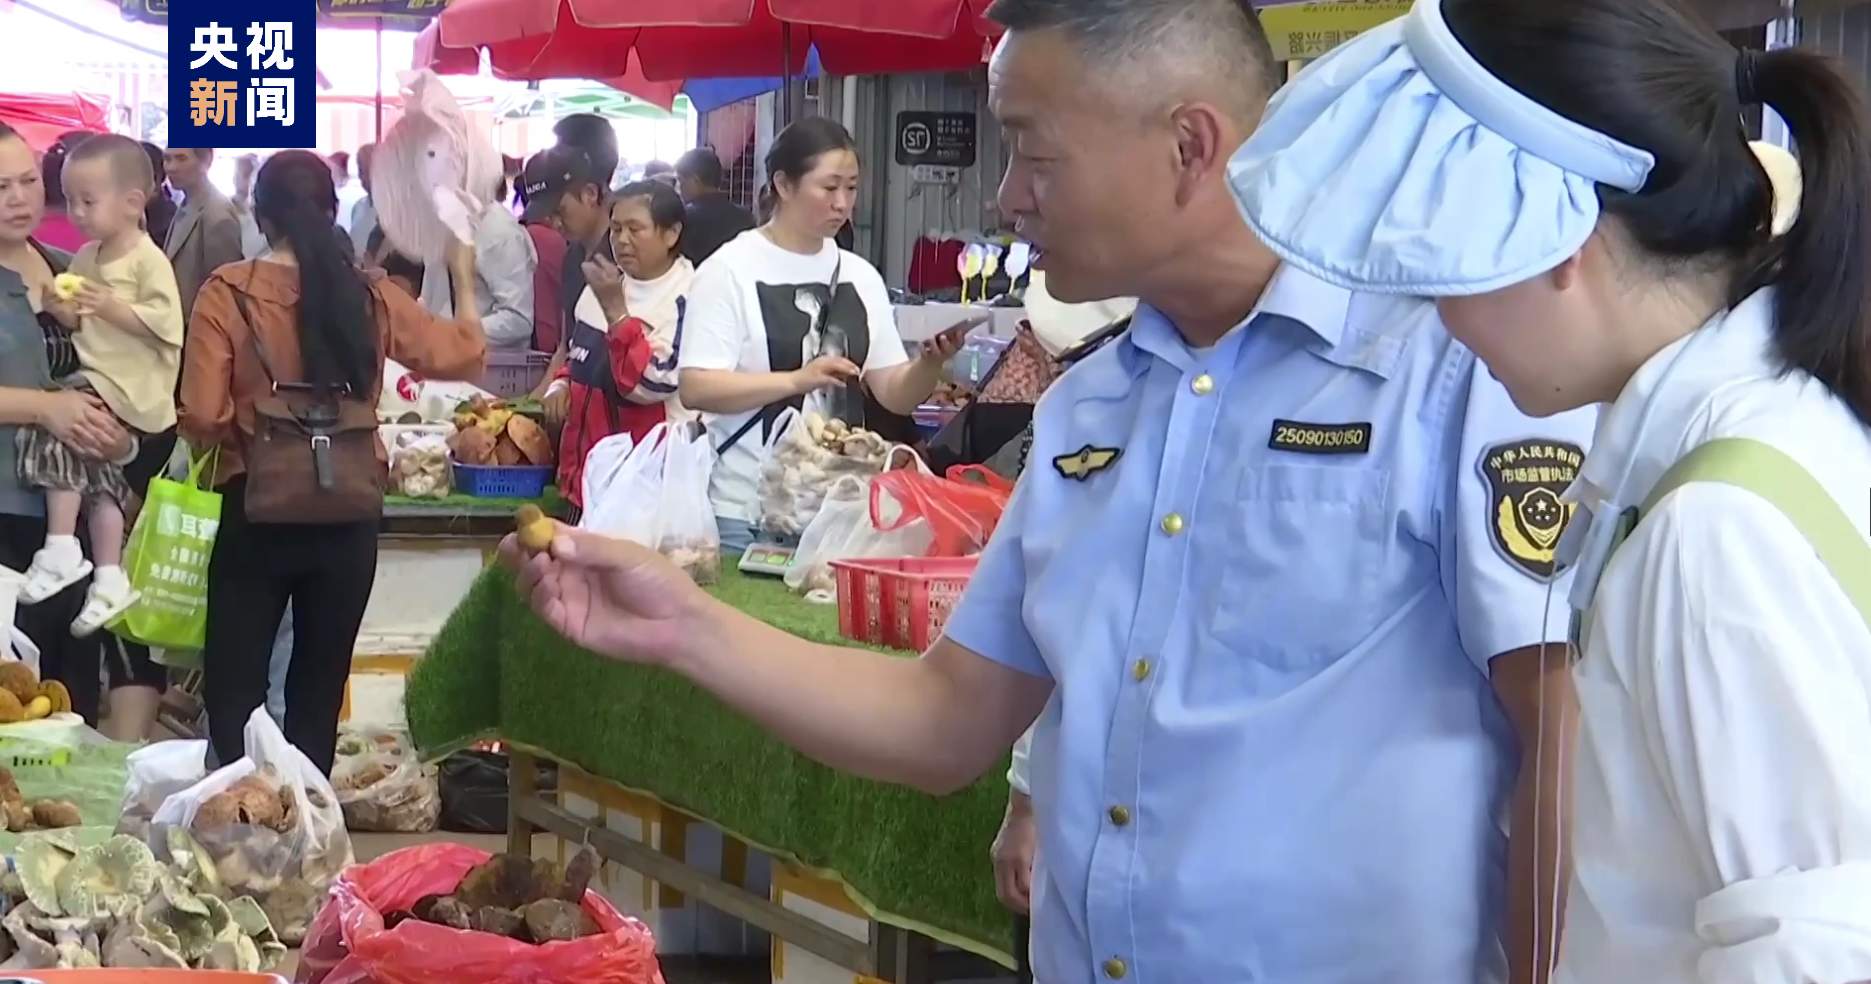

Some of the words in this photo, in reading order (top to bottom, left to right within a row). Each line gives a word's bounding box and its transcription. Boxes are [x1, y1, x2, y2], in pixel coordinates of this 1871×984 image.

[1275, 426, 1363, 446] 25090130150
[1490, 445, 1581, 468] 中华人民共和国
[1501, 467, 1574, 483] 市场监管执法
